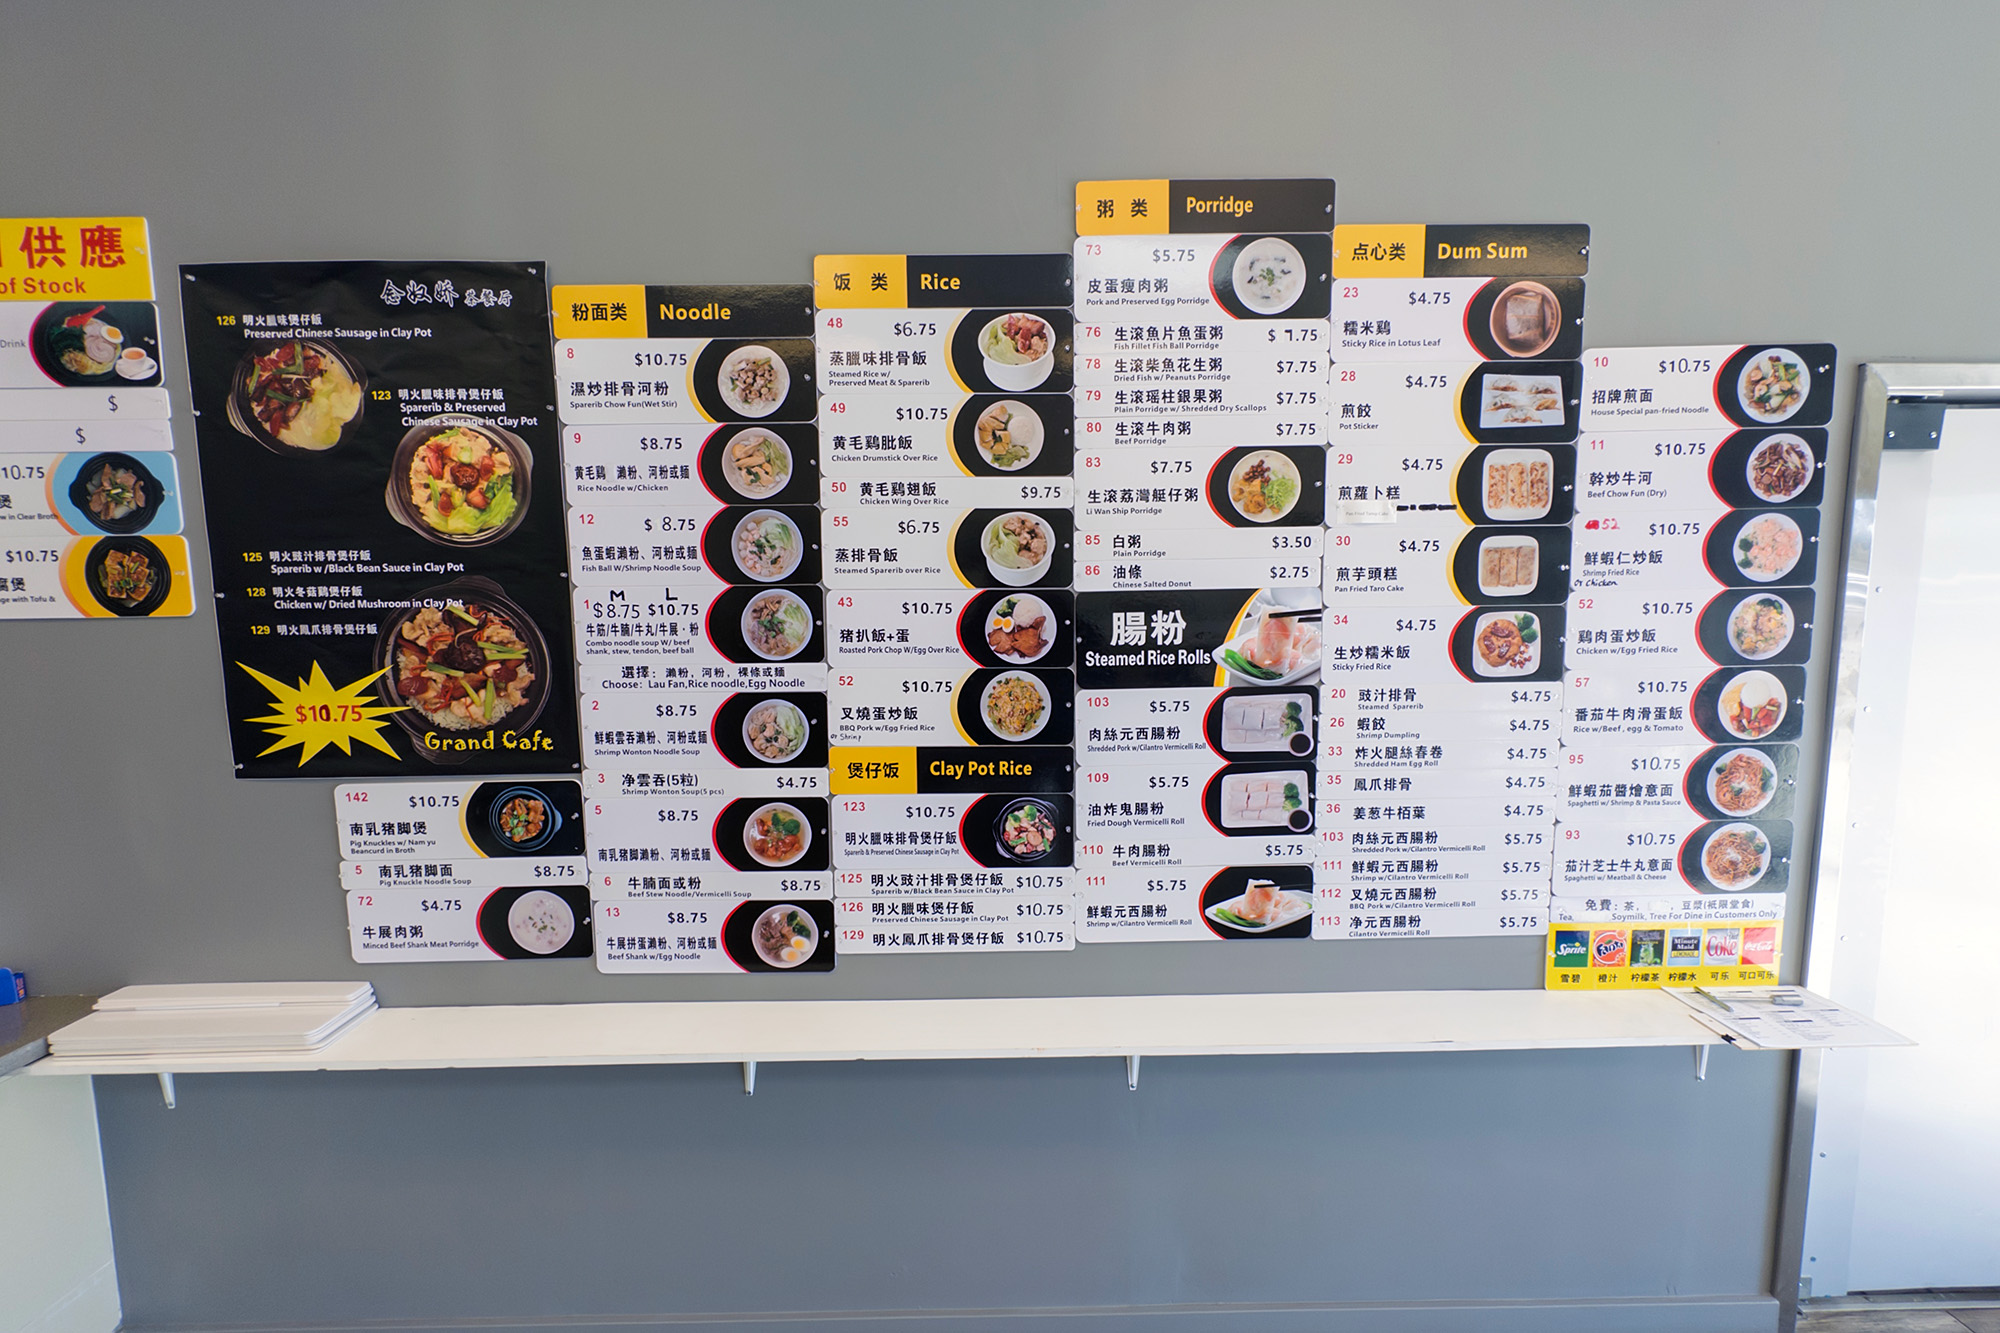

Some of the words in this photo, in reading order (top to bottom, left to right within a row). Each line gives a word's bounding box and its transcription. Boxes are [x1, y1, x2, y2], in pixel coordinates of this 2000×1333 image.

[1187, 196, 1253, 217] Porridge
[0, 225, 125, 269] 供應
[1352, 243, 1405, 261] 点心类
[1438, 243, 1481, 259] Dum
[1487, 243, 1527, 259] Sum
[1086, 245, 1101, 255] 73
[1153, 249, 1194, 263] $5.75
[23, 277, 86, 294] Stock
[921, 273, 960, 289] Rice
[1088, 278, 1168, 293] 皮蛋瘦肉粥
[1161, 298, 1175, 306] Egg
[1344, 287, 1358, 297] 23
[1409, 292, 1450, 305] $4.75
[572, 303, 627, 321] 粉面类
[660, 303, 731, 320] Noodle
[217, 316, 236, 325] 126
[827, 318, 842, 328] 48
[894, 322, 936, 336] $6.75
[244, 328, 293, 338] Preserved
[295, 328, 333, 338] Chinese
[335, 328, 378, 340] Sausage
[380, 328, 389, 337] in
[391, 328, 412, 339] Clay
[414, 328, 432, 337] Pot
[1086, 327, 1100, 337] 76
[0, 340, 26, 348] Drink
[1342, 340, 1367, 349] Sticky
[635, 353, 687, 367] $10.75
[1594, 357, 1608, 367] 10
[1659, 358, 1710, 373] $10.75
[1277, 360, 1316, 374] $7.75
[1592, 389, 1653, 404] 招牌煎面
[897, 408, 947, 421] $10.75
[1341, 404, 1371, 418] 煎餃
[641, 438, 682, 450] $8.75
[1022, 486, 1060, 499] $9.75
[1588, 490, 1605, 498] Beef
[1647, 489, 1667, 498] (Dry)
[580, 514, 594, 524] 12
[834, 517, 848, 526] 55
[1602, 518, 1619, 530] 52
[1085, 535, 1100, 545] 85
[1114, 535, 1140, 548] 白粥
[1273, 536, 1311, 549] $3.50
[1336, 536, 1350, 546] 30
[6, 550, 59, 563] $10.75
[243, 552, 262, 561] 125
[835, 548, 897, 562] 蒸排骨飯
[1134, 550, 1166, 558] Porridge
[1114, 565, 1141, 579] 油條
[1271, 567, 1308, 579] $2.75
[1337, 567, 1397, 581] 煎芋頭糕
[610, 590, 625, 601] M
[666, 588, 678, 601] L
[648, 604, 698, 616] $10.75
[251, 626, 270, 634] 129
[1110, 610, 1186, 646] 腸粉
[1086, 650, 1144, 666] Steamed
[1148, 650, 1175, 665] Rice
[1178, 649, 1210, 664] Rolls
[602, 680, 642, 688] Choose:
[649, 680, 665, 688] Lau
[770, 679, 805, 687] Noodle
[839, 676, 853, 686] 52
[1576, 678, 1589, 687] 57
[1638, 681, 1687, 693] $10.75
[1088, 697, 1109, 707] 103
[1150, 701, 1189, 713] $5.75
[295, 703, 363, 724] $10.75
[841, 707, 917, 720] 叉燒蛋炒飯
[1575, 707, 1682, 721] 番茄牛肉滑蛋飯
[1357, 717, 1385, 730] 蝦餃
[1510, 720, 1549, 731] $4.75
[423, 730, 494, 750] Grand
[502, 730, 553, 750] Cafe
[1569, 755, 1583, 764] 95
[848, 762, 899, 779] 煲仔饭
[930, 761, 964, 779] Clay
[969, 761, 995, 775] Pot
[1000, 761, 1032, 775] Rice
[777, 777, 816, 788] $4.75
[346, 792, 368, 802] 142
[409, 796, 459, 808] $10.75
[844, 802, 865, 811] 123
[906, 806, 954, 818] $10.75
[1089, 802, 1164, 816] 油炸鬼腸粉
[350, 822, 427, 836] 南乳猪脚煲
[1108, 819, 1131, 828] Dough
[1083, 845, 1103, 854] 110
[1113, 844, 1170, 858] 牛肉腸粉
[1017, 875, 1063, 888] $10.75
[358, 896, 372, 905] 72
[422, 900, 461, 911] $4.75
[668, 912, 707, 924] $8.75
[1320, 916, 1340, 925] 113
[1500, 917, 1536, 928] $5.75
[1612, 913, 1647, 922] Soymilk,
[1759, 910, 1777, 920] Only
[363, 925, 423, 939] 牛展肉粥
[843, 930, 864, 939] 129
[1673, 937, 1698, 945] Minute
[1556, 943, 1587, 957] Sprite
[1561, 974, 1581, 983] 雪碧
[1598, 974, 1617, 982] 橙汁
[1631, 973, 1659, 982] 柠檬茶
[1669, 973, 1696, 981] 柠檬水
[1709, 971, 1730, 981] 可乐
[1738, 970, 1775, 980] 可口可乐
